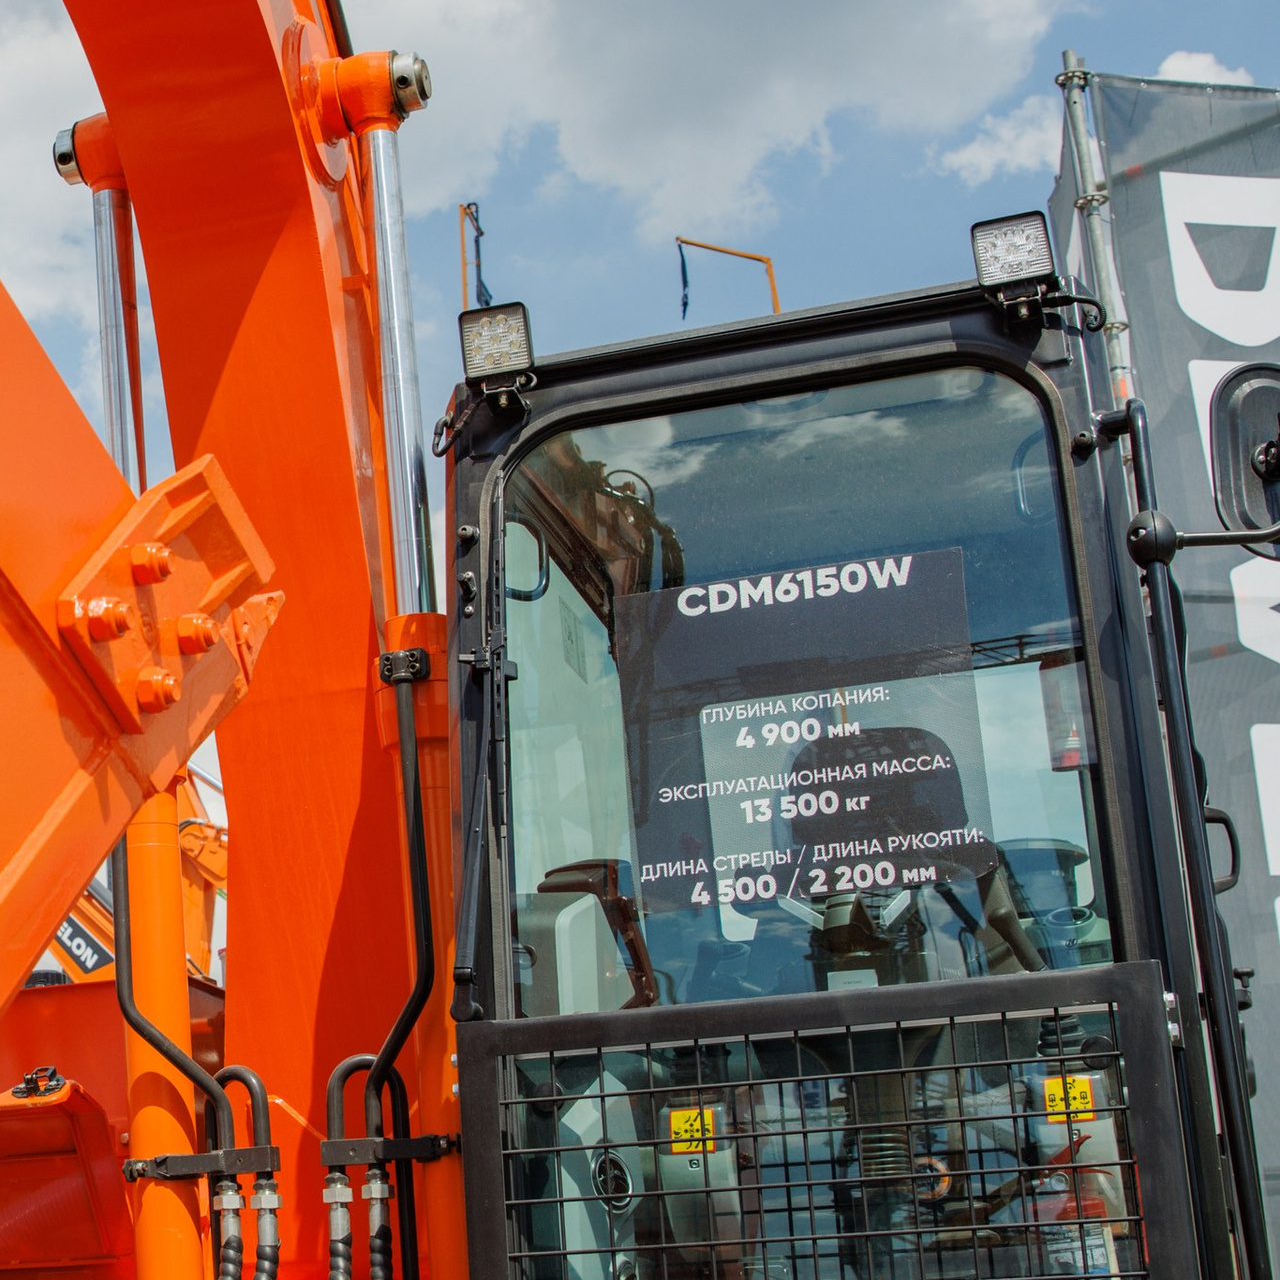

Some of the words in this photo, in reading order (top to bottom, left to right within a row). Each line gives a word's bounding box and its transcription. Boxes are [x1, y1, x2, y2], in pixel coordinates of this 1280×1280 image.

[677, 555, 912, 617] CDM6150W
[702, 700, 787, 725] ГЛУБИНА
[792, 685, 891, 713] КОПАНИЯ:
[735, 726, 755, 749] 4
[761, 718, 821, 747] 900
[828, 720, 860, 739] мм
[658, 763, 867, 804] ЭКСПЛУАТАЦИОННАЯ
[872, 754, 951, 777] МАССА:
[740, 796, 772, 824] 13
[780, 790, 838, 820] 500
[845, 794, 870, 812] кг
[641, 861, 708, 882] ДЛИНА
[713, 848, 792, 872] СТРЕЛЫ
[797, 845, 807, 865] /
[812, 840, 883, 863] ДЛИНА
[888, 828, 985, 852] РУКОЯТИ:
[691, 881, 711, 905] 4
[717, 874, 777, 900] 500
[786, 867, 801, 898] /
[808, 868, 828, 894] 2
[835, 861, 895, 890] 200
[902, 865, 937, 883] мм
